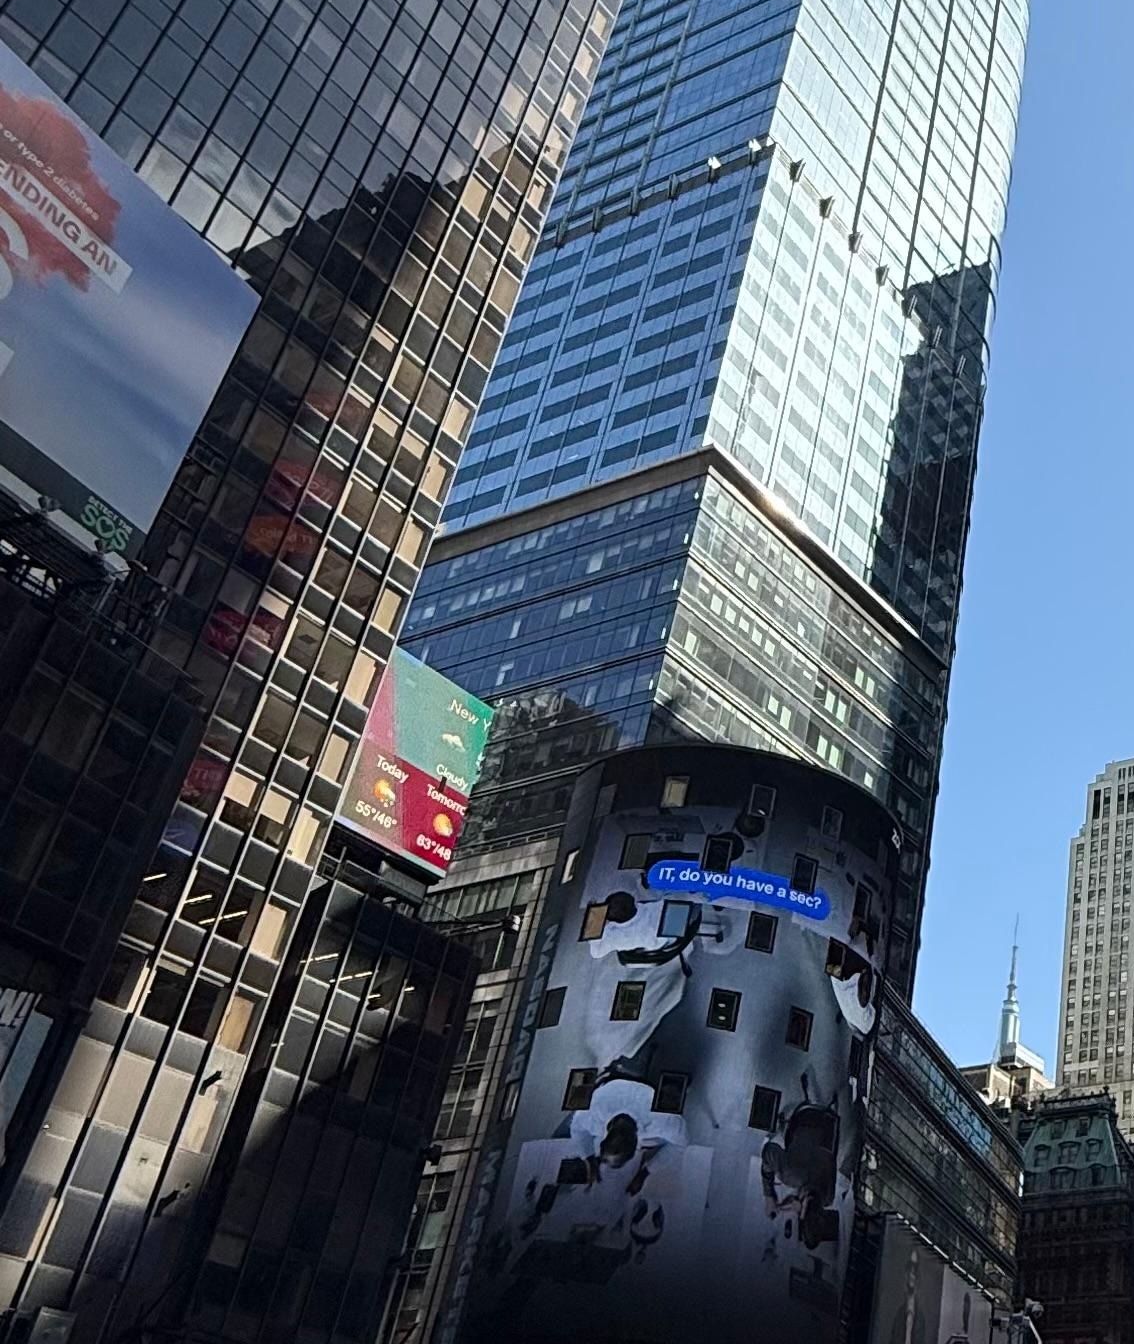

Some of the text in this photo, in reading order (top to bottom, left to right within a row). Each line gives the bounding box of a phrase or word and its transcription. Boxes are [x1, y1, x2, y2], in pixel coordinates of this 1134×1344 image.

[17, 141, 45, 169] type
[43, 166, 55, 177] 2
[52, 175, 100, 222] diabetes
[81, 240, 118, 276] AN
[450, 699, 480, 725] New
[377, 755, 410, 783] Today
[658, 867, 823, 909] IT, do you have a sec?
